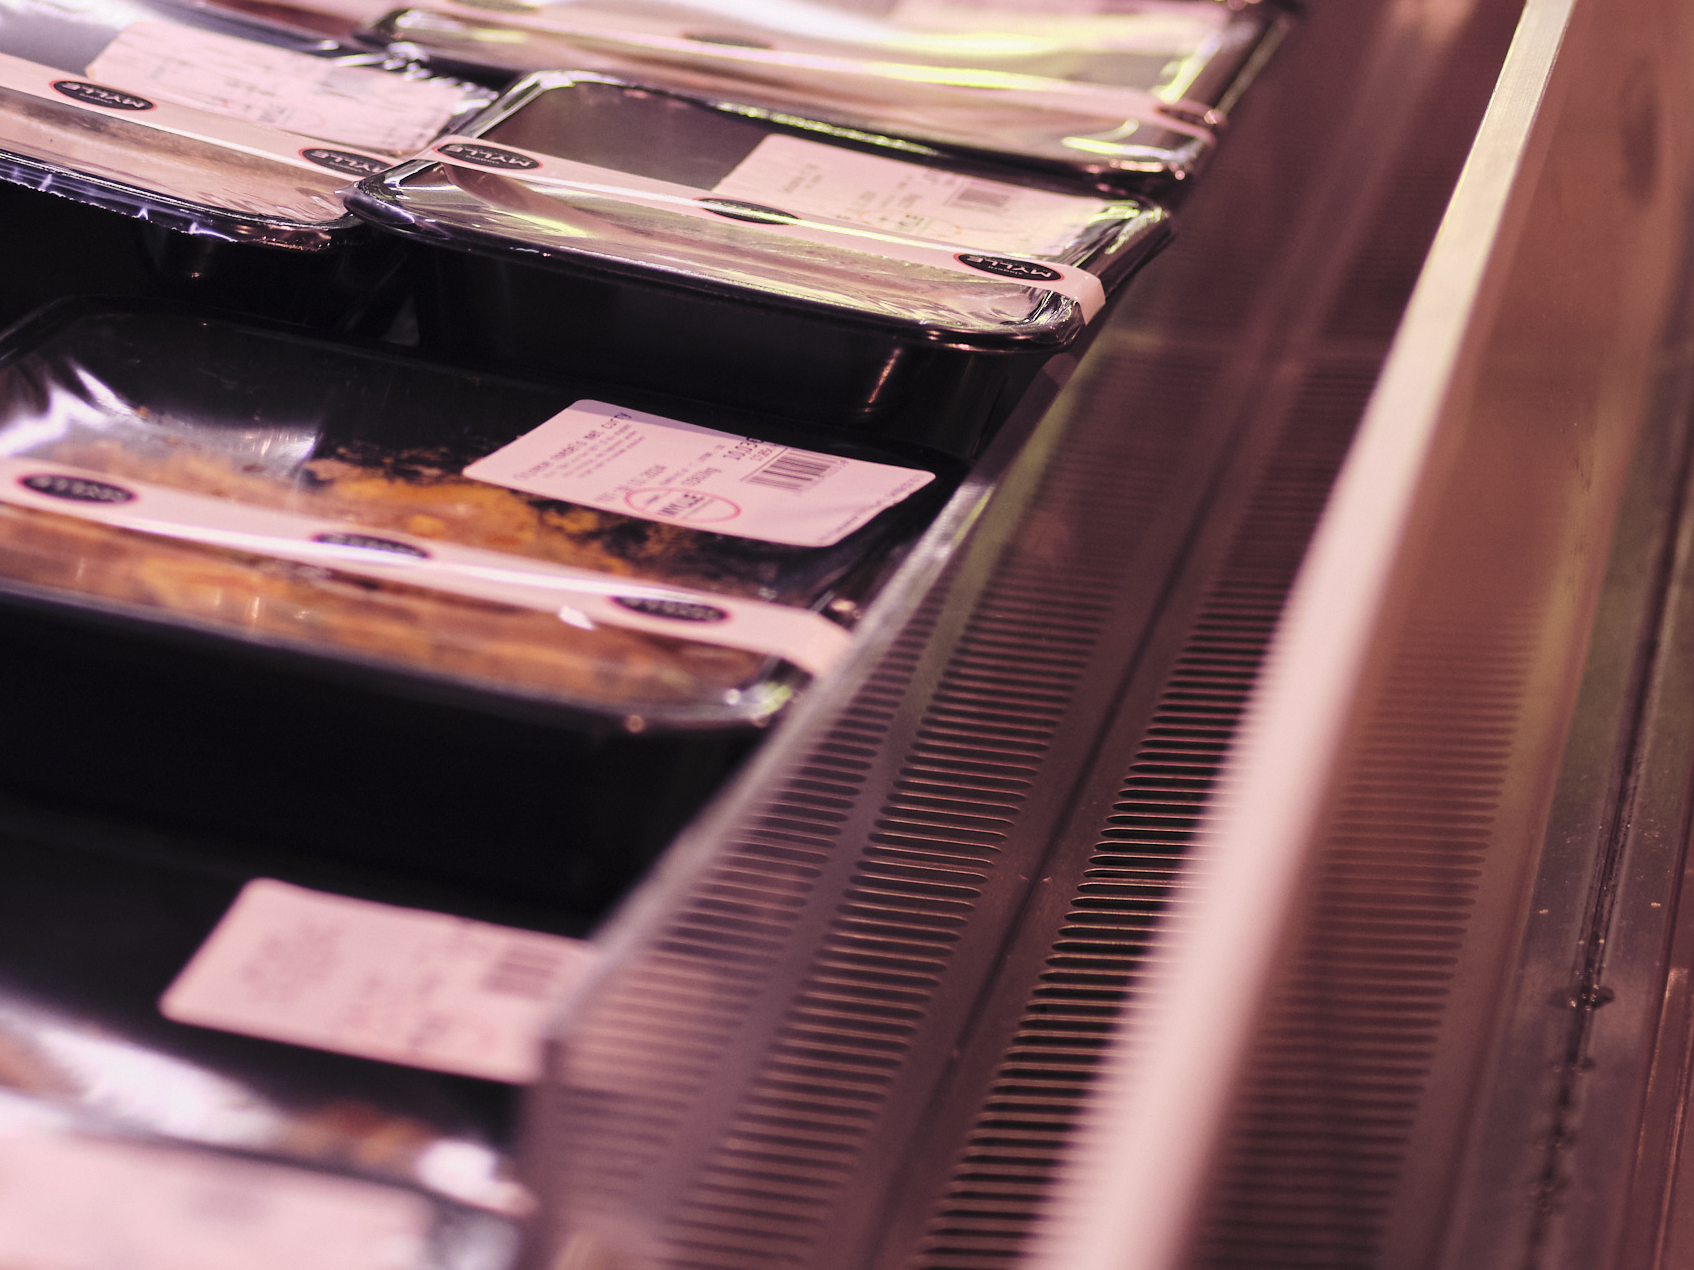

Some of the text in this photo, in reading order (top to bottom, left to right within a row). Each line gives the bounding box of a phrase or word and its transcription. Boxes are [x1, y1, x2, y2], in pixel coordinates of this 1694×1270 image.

[62, 82, 145, 109] MYLLE
[445, 145, 533, 167] MYLLE
[967, 255, 1053, 278] MYLLE
